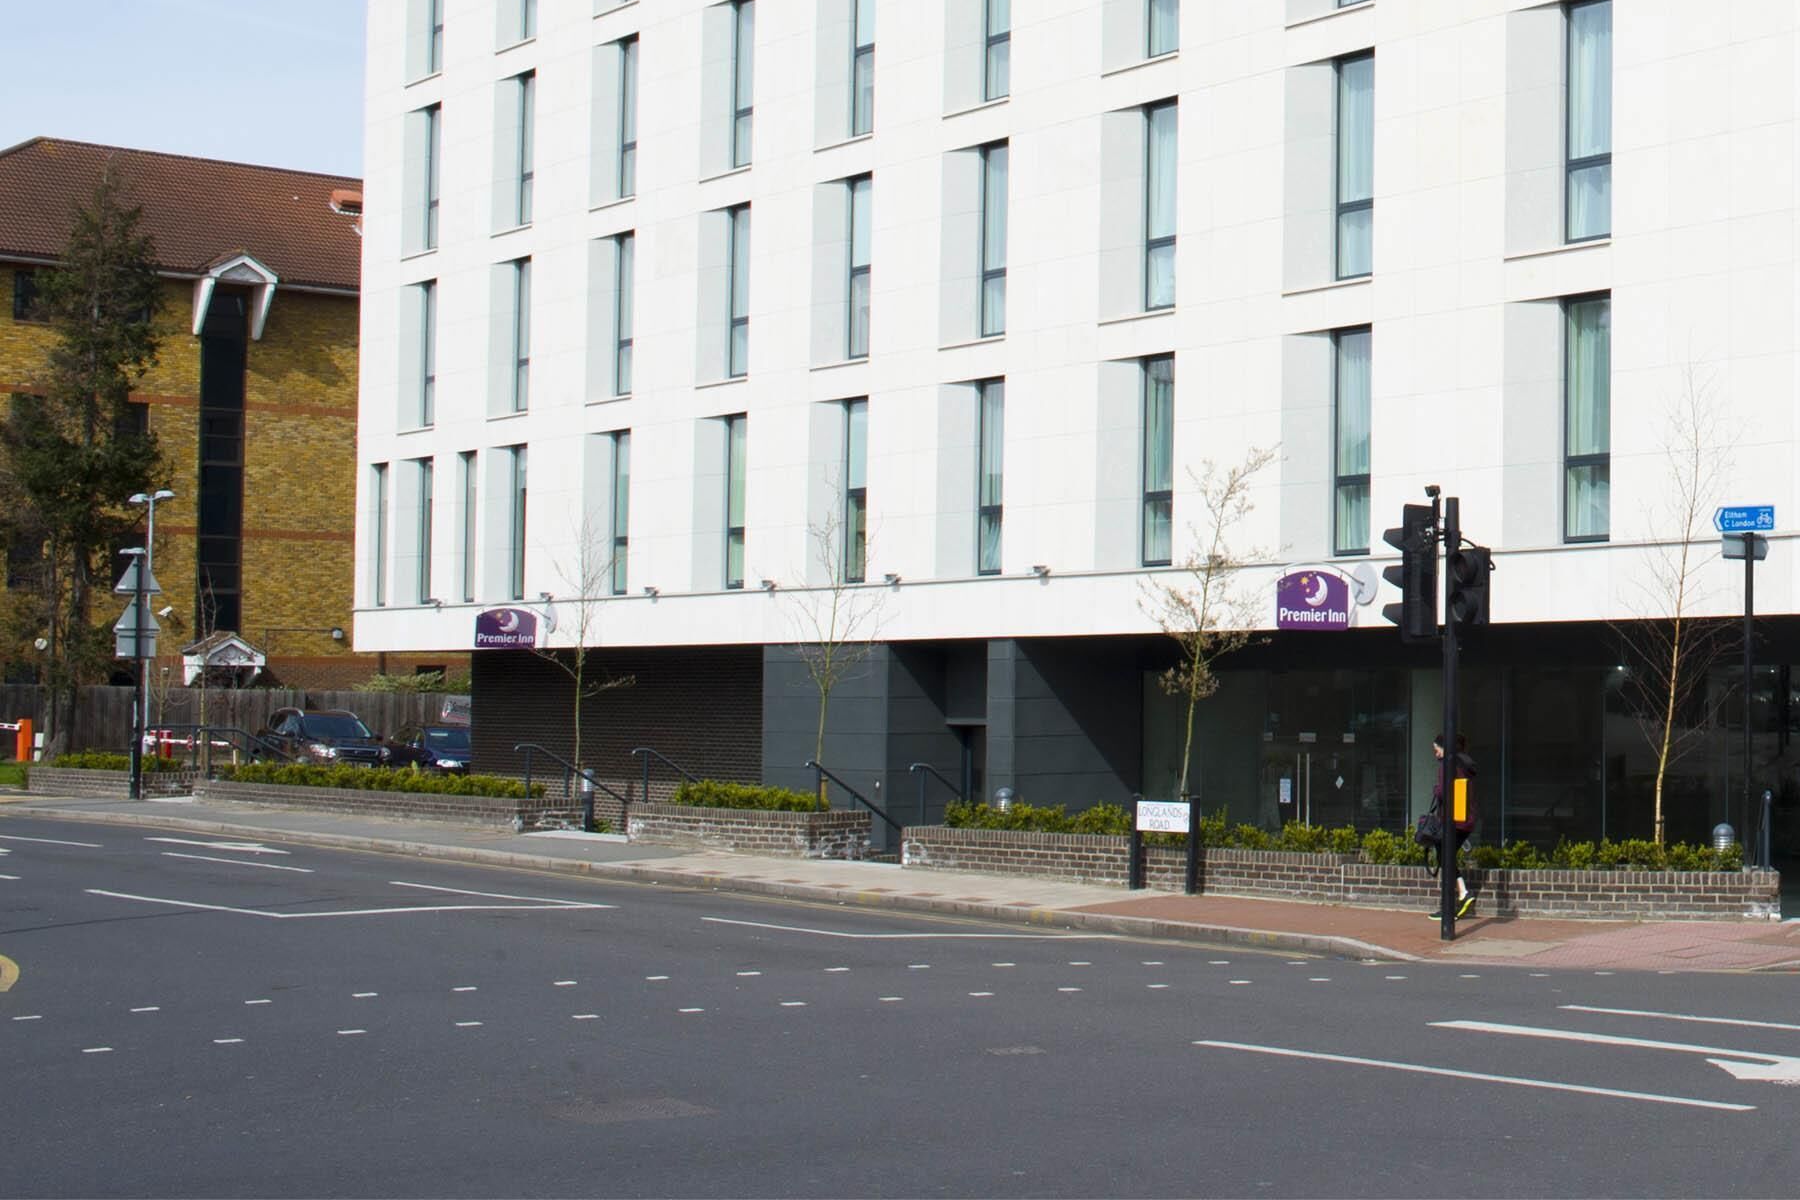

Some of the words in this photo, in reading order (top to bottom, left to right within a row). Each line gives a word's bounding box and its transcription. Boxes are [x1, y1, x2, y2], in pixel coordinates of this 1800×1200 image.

[1724, 510, 1748, 519] Eltham
[1723, 519, 1731, 528] C
[1731, 518, 1756, 528] London
[1279, 607, 1328, 623] Premier
[1327, 608, 1347, 623] Inn
[476, 632, 517, 644] Premier
[518, 633, 535, 644] Inn
[1139, 806, 1183, 818] LONGLANDS
[1149, 818, 1170, 830] ROAD
